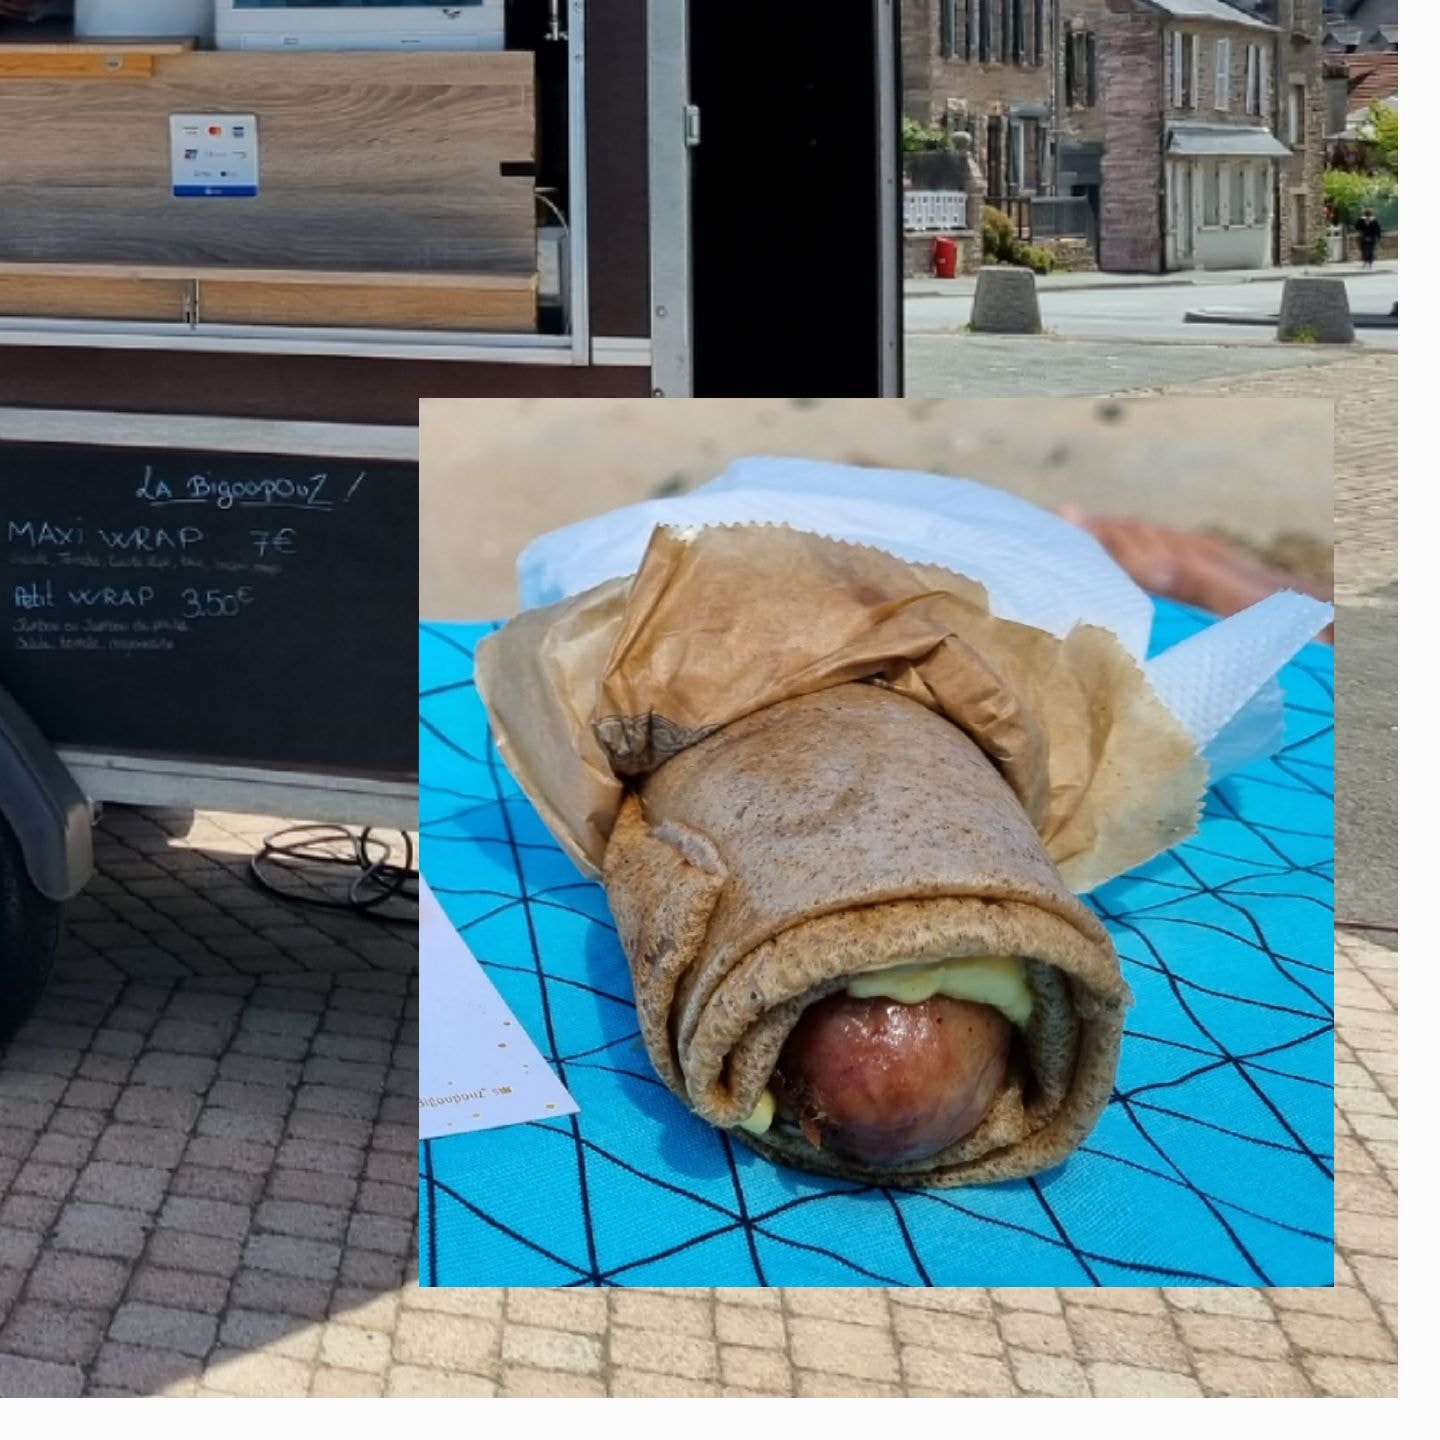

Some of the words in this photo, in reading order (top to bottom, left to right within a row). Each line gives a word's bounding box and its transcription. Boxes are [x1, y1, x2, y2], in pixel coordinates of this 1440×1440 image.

[98, 525, 205, 552] WRAP
[252, 527, 298, 556] 7€
[68, 585, 155, 608] WRAP
